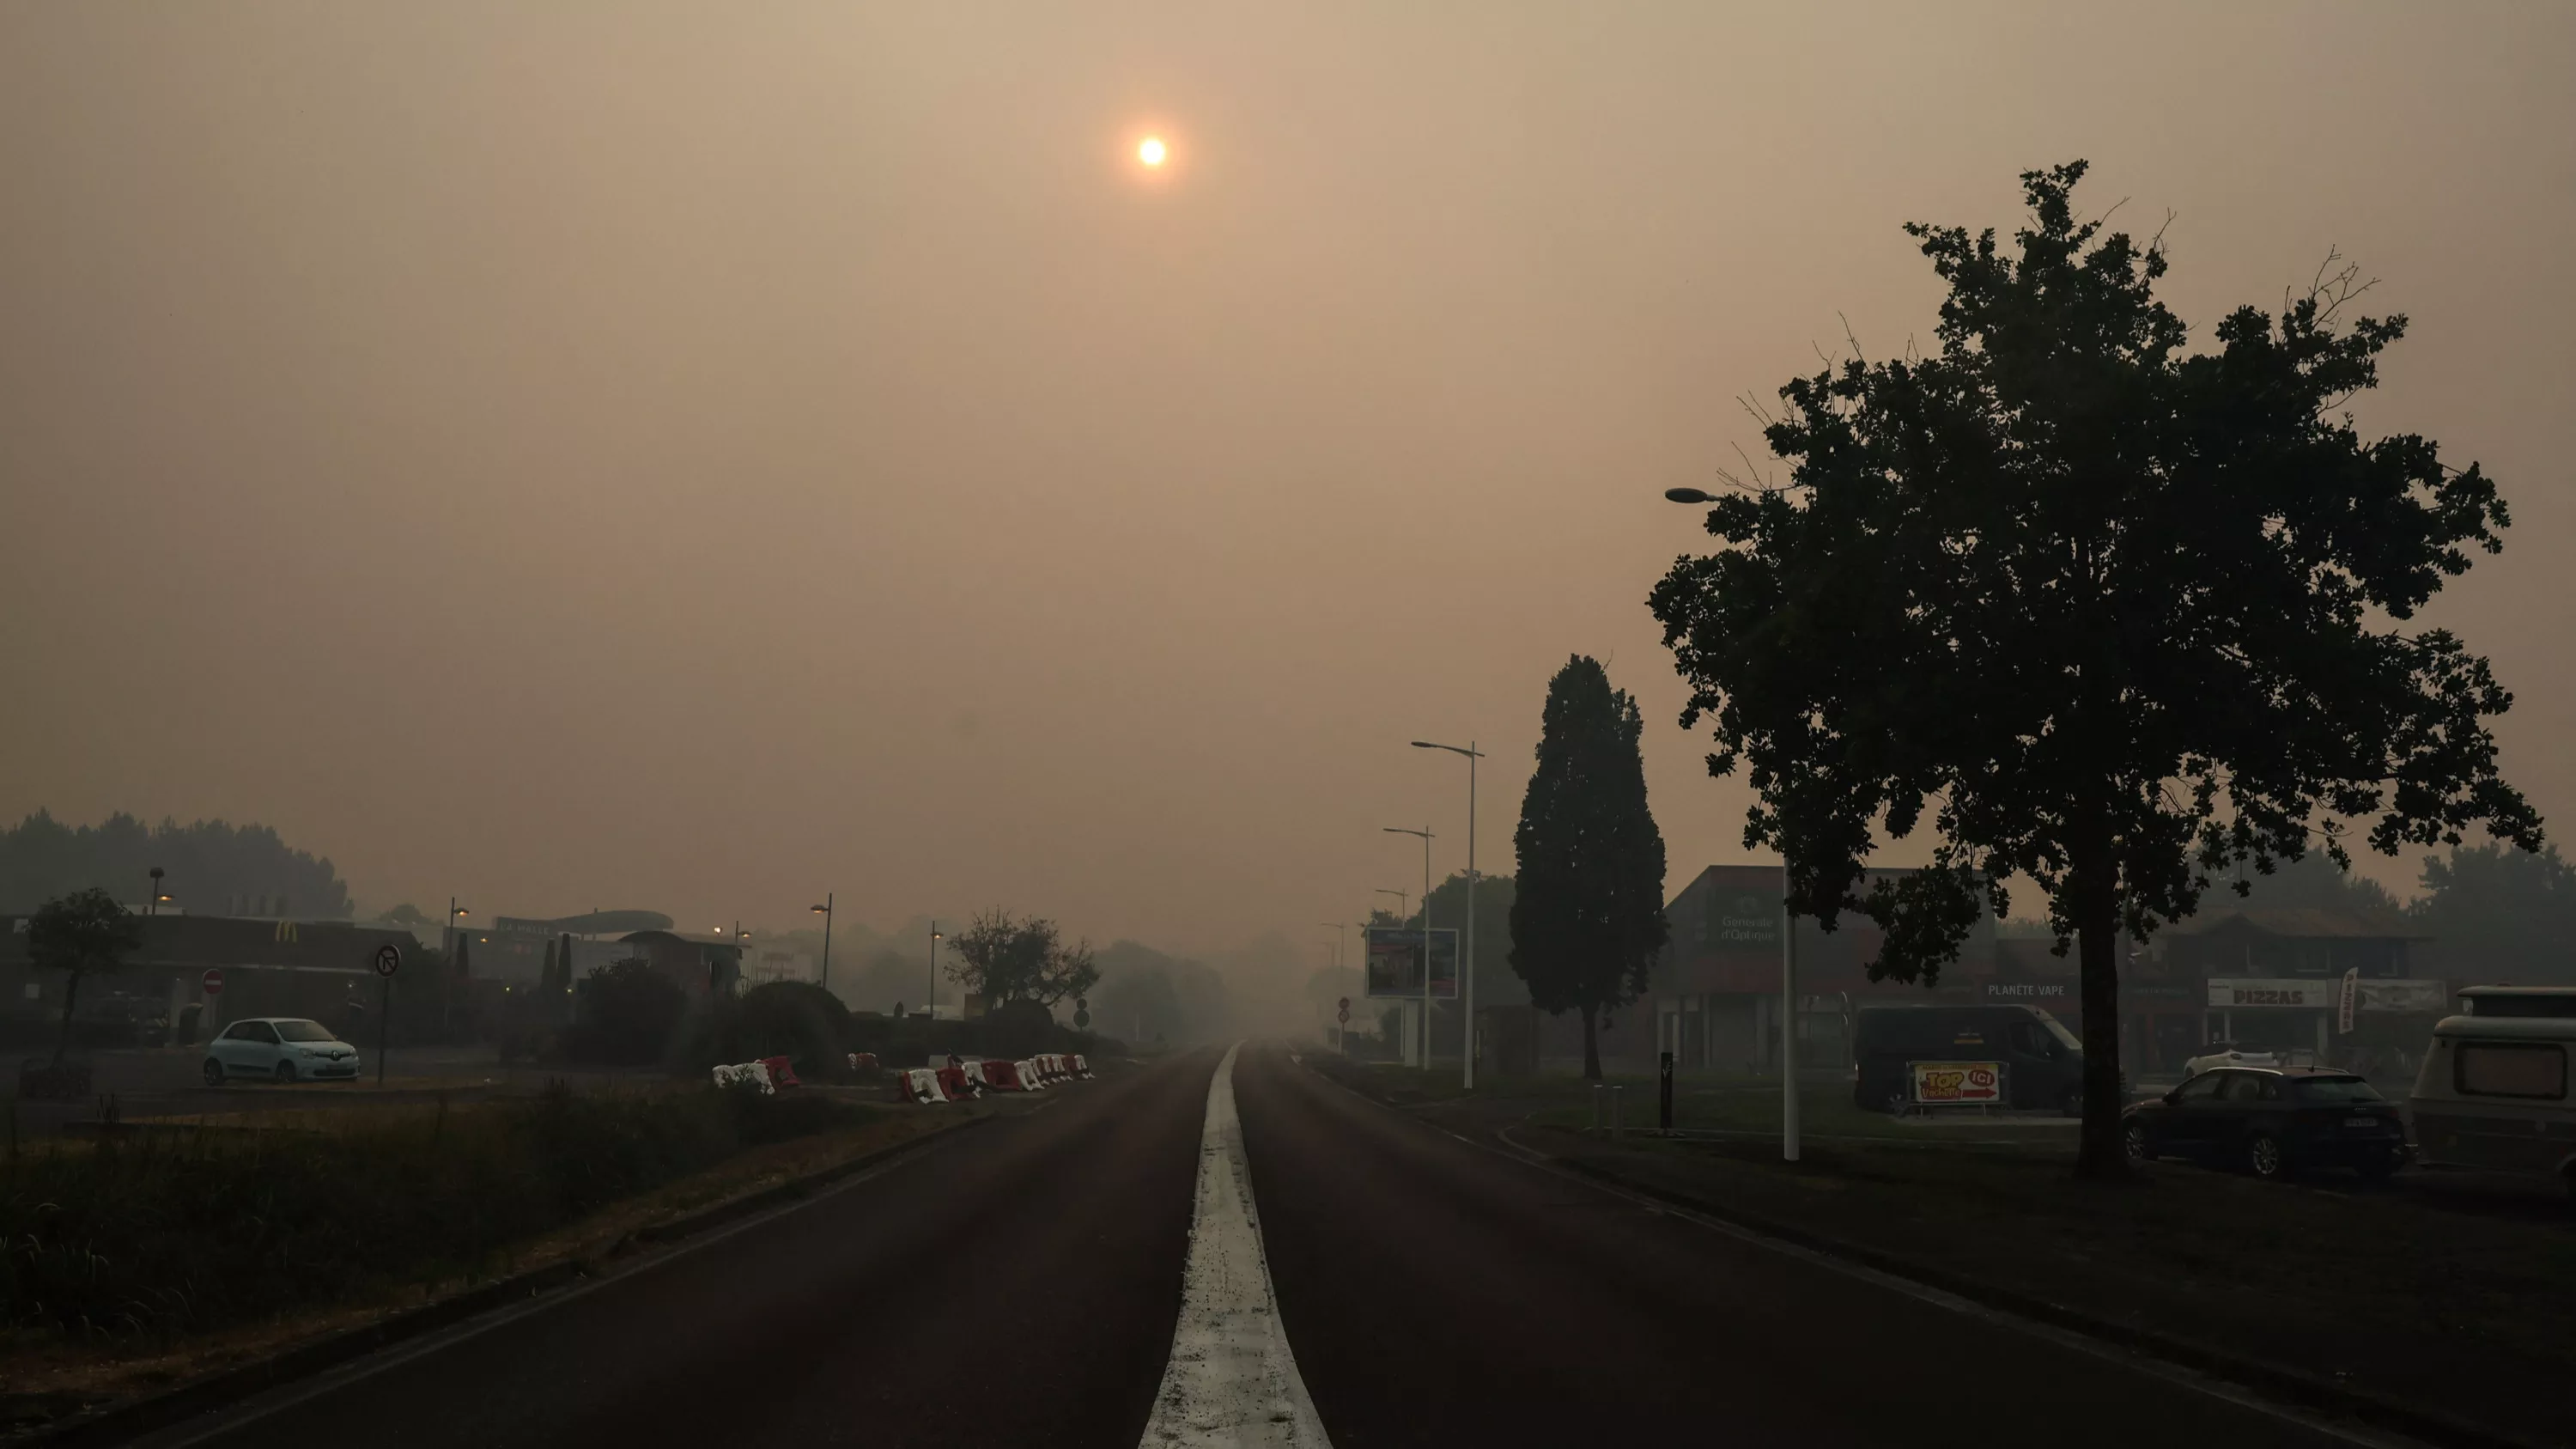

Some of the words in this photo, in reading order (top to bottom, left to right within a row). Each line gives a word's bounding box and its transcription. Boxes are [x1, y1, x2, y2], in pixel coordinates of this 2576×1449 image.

[2038, 984, 2065, 995] VAPE
[2233, 989, 2303, 1004] PIZZAS
[1926, 1071, 1965, 1088] TOP
[1971, 1071, 1992, 1084] ICI
